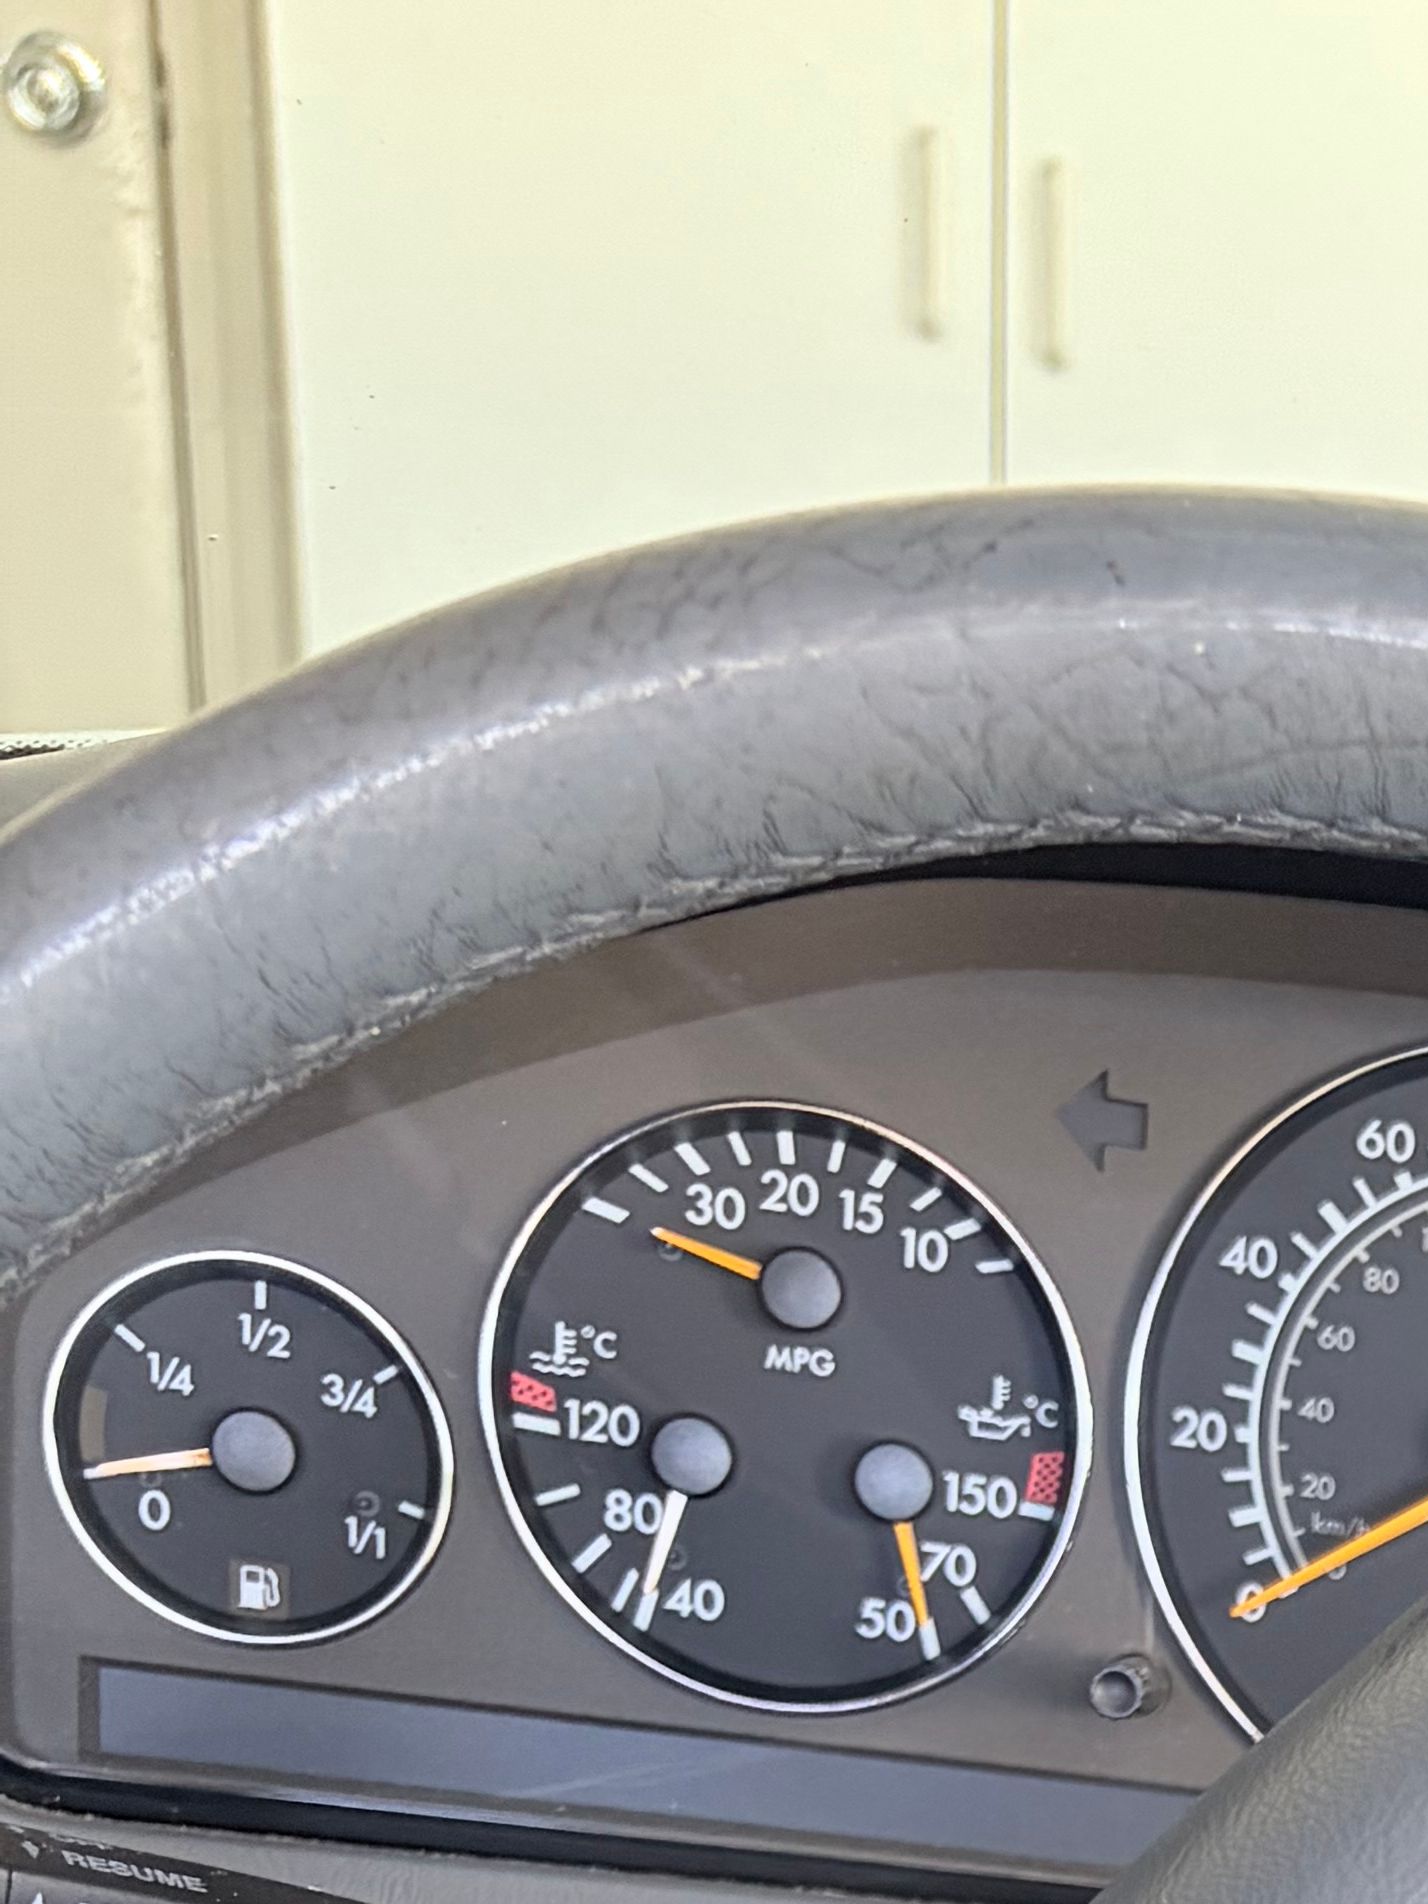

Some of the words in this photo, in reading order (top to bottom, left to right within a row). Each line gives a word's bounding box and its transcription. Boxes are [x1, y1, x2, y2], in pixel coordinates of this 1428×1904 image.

[1357, 1121, 1415, 1165] 60
[685, 1185, 747, 1226] 30
[760, 1173, 819, 1214] 20
[839, 1190, 884, 1233] 15
[900, 1230, 949, 1271] 10
[1221, 1238, 1277, 1279] 40
[1364, 1267, 1400, 1294] 80
[237, 1313, 292, 1360] 1/2
[1319, 1324, 1355, 1352] 60
[146, 1353, 195, 1397] 1/4
[764, 1344, 836, 1377] MPG
[320, 1373, 378, 1420] 3/4
[1299, 1398, 1335, 1423] 40
[564, 1402, 640, 1444] 120
[1170, 1409, 1226, 1451] 20
[942, 1472, 1016, 1513] 150
[1301, 1475, 1336, 1501] 20
[137, 1490, 171, 1530] 0
[604, 1491, 660, 1535] 80
[345, 1515, 388, 1560] 1/1
[920, 1544, 977, 1584] 70
[664, 1580, 724, 1622] 40
[855, 1600, 916, 1642] 50
[61, 1850, 208, 1893] RESUME
